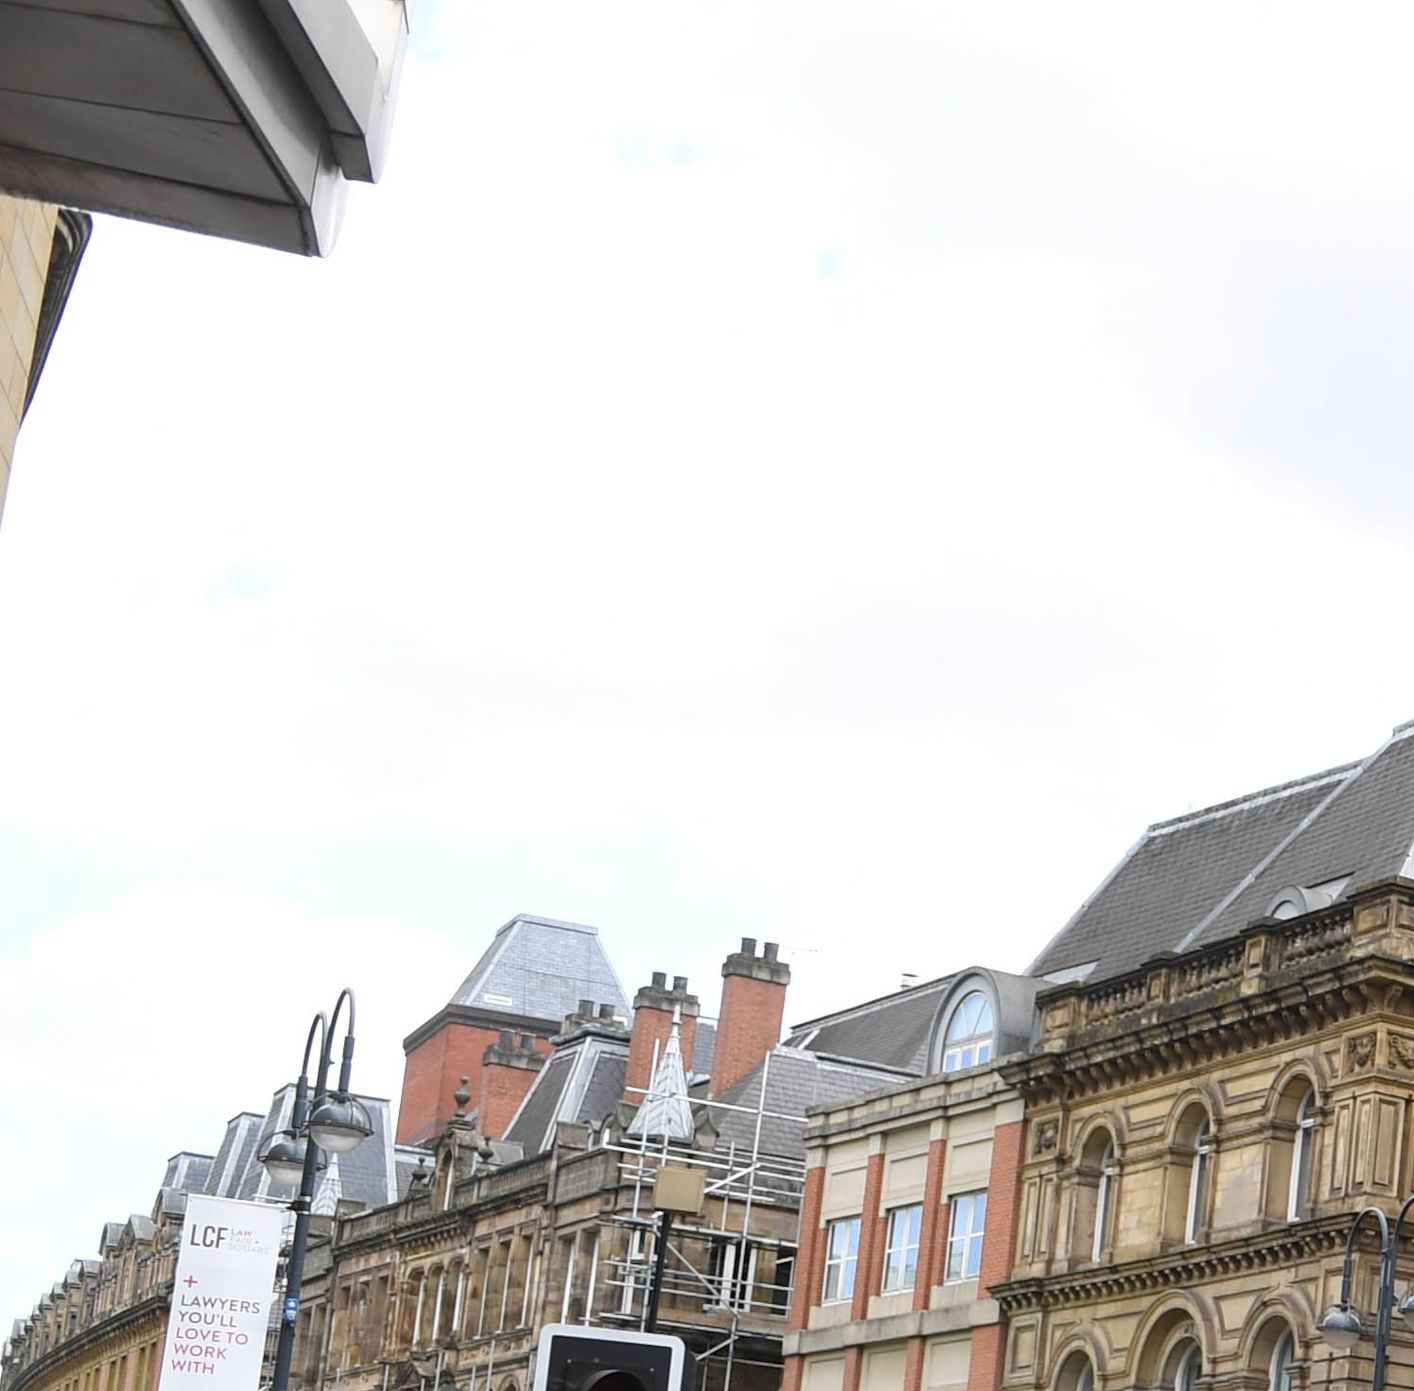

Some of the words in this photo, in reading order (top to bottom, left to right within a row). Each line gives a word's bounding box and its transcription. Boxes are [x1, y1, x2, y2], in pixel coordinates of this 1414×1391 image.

[190, 1224, 228, 1248] LCF
[181, 1294, 261, 1314] LAWYERS
[178, 1311, 237, 1328] YOU'LL
[176, 1327, 222, 1343] LOVE
[227, 1332, 248, 1345] TO
[174, 1343, 227, 1360] WORK
[171, 1359, 215, 1375] WITH
